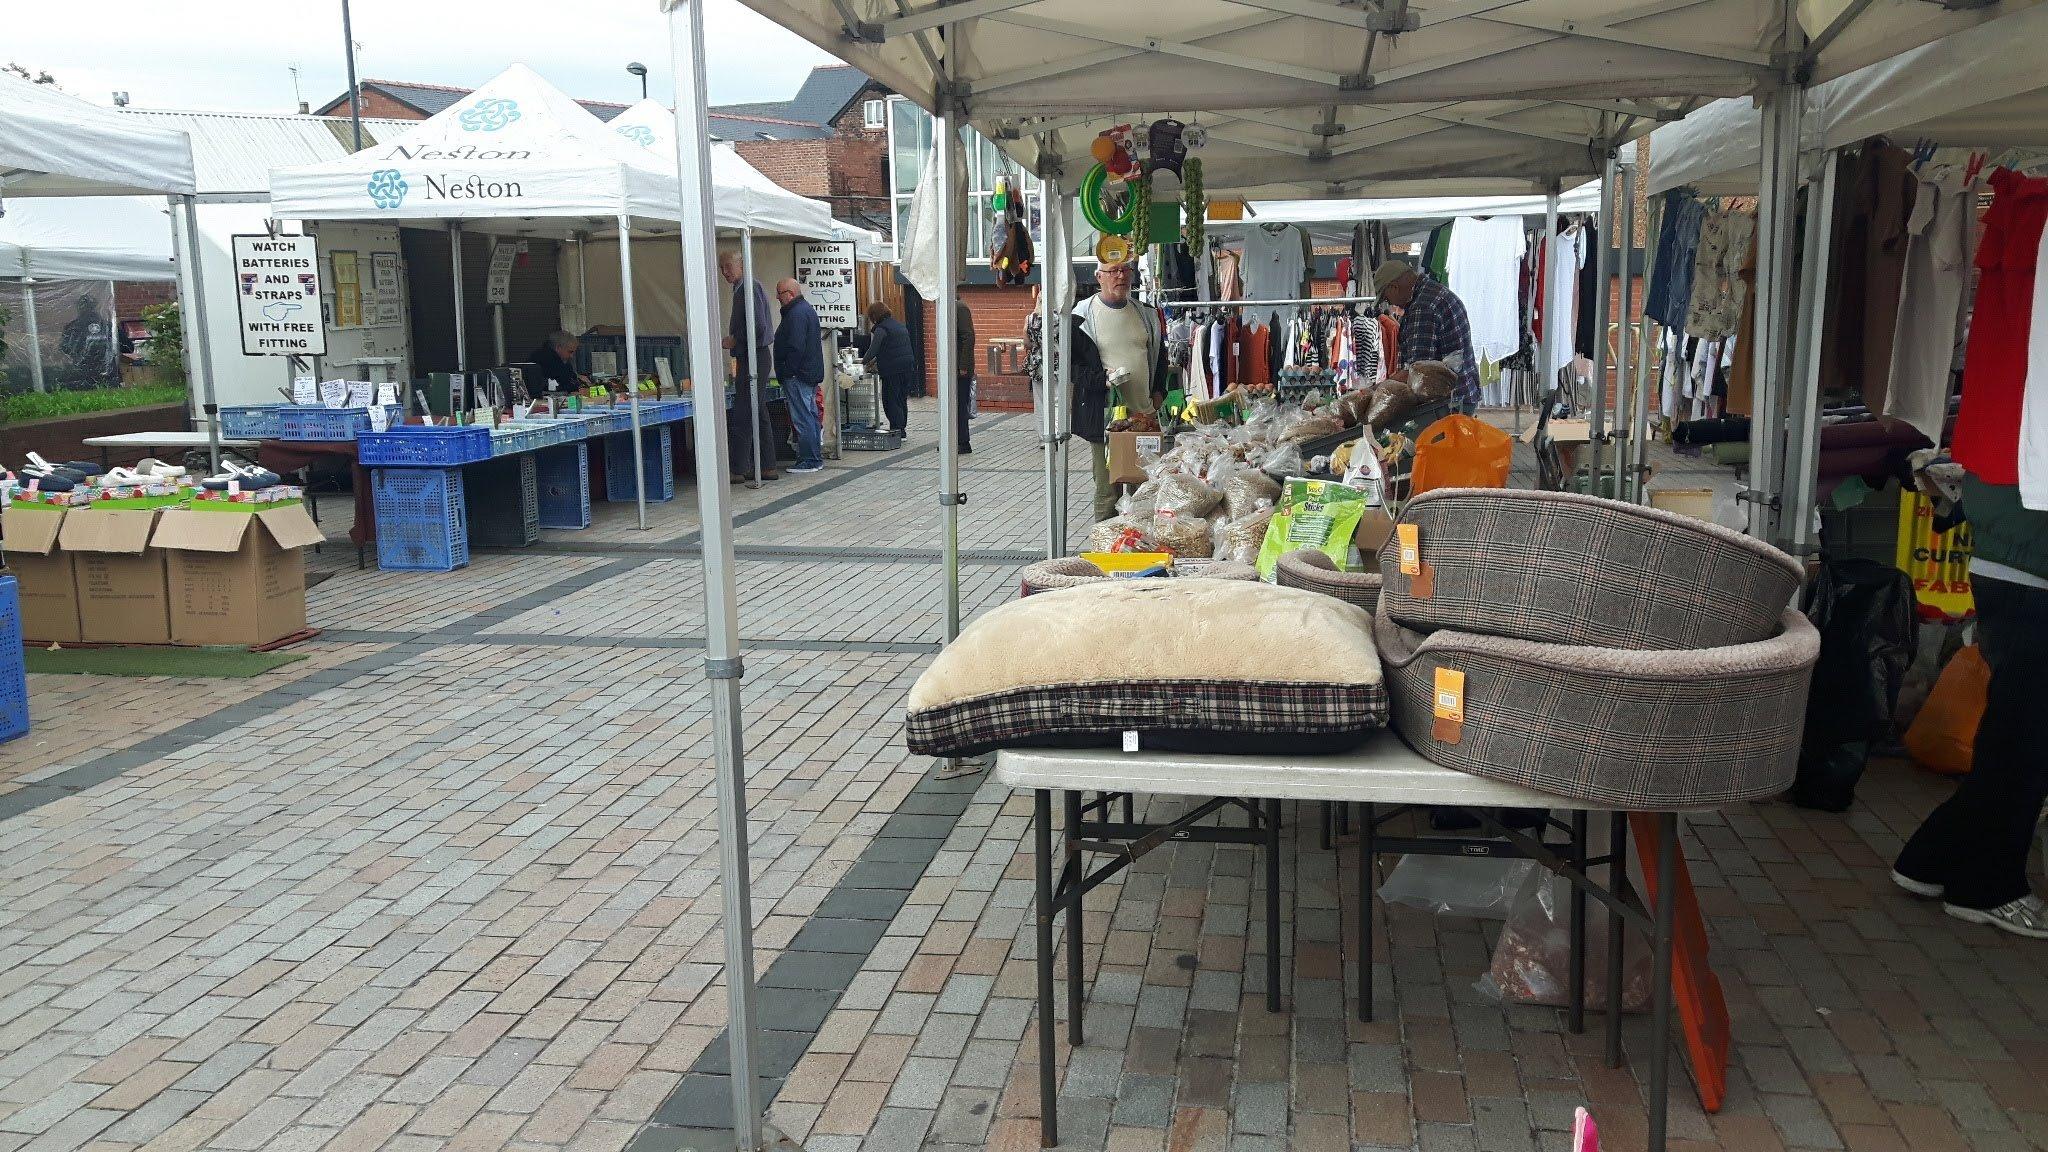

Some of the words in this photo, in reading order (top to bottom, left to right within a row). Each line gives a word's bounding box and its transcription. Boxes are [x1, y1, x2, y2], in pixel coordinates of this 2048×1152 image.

[385, 143, 531, 160] Neston
[424, 174, 524, 200] Neston
[252, 242, 296, 252] WATCH
[808, 245, 840, 253] WATCH
[242, 258, 310, 268] BATTERIES
[800, 257, 849, 265] BATTERIES
[264, 274, 290, 284] AND
[808, 280, 843, 288] STRAPS
[255, 290, 303, 300] STRAPS
[828, 304, 851, 312] FREE
[248, 322, 280, 332] WITH
[283, 322, 315, 333] FREE
[258, 338, 308, 348] FITTING
